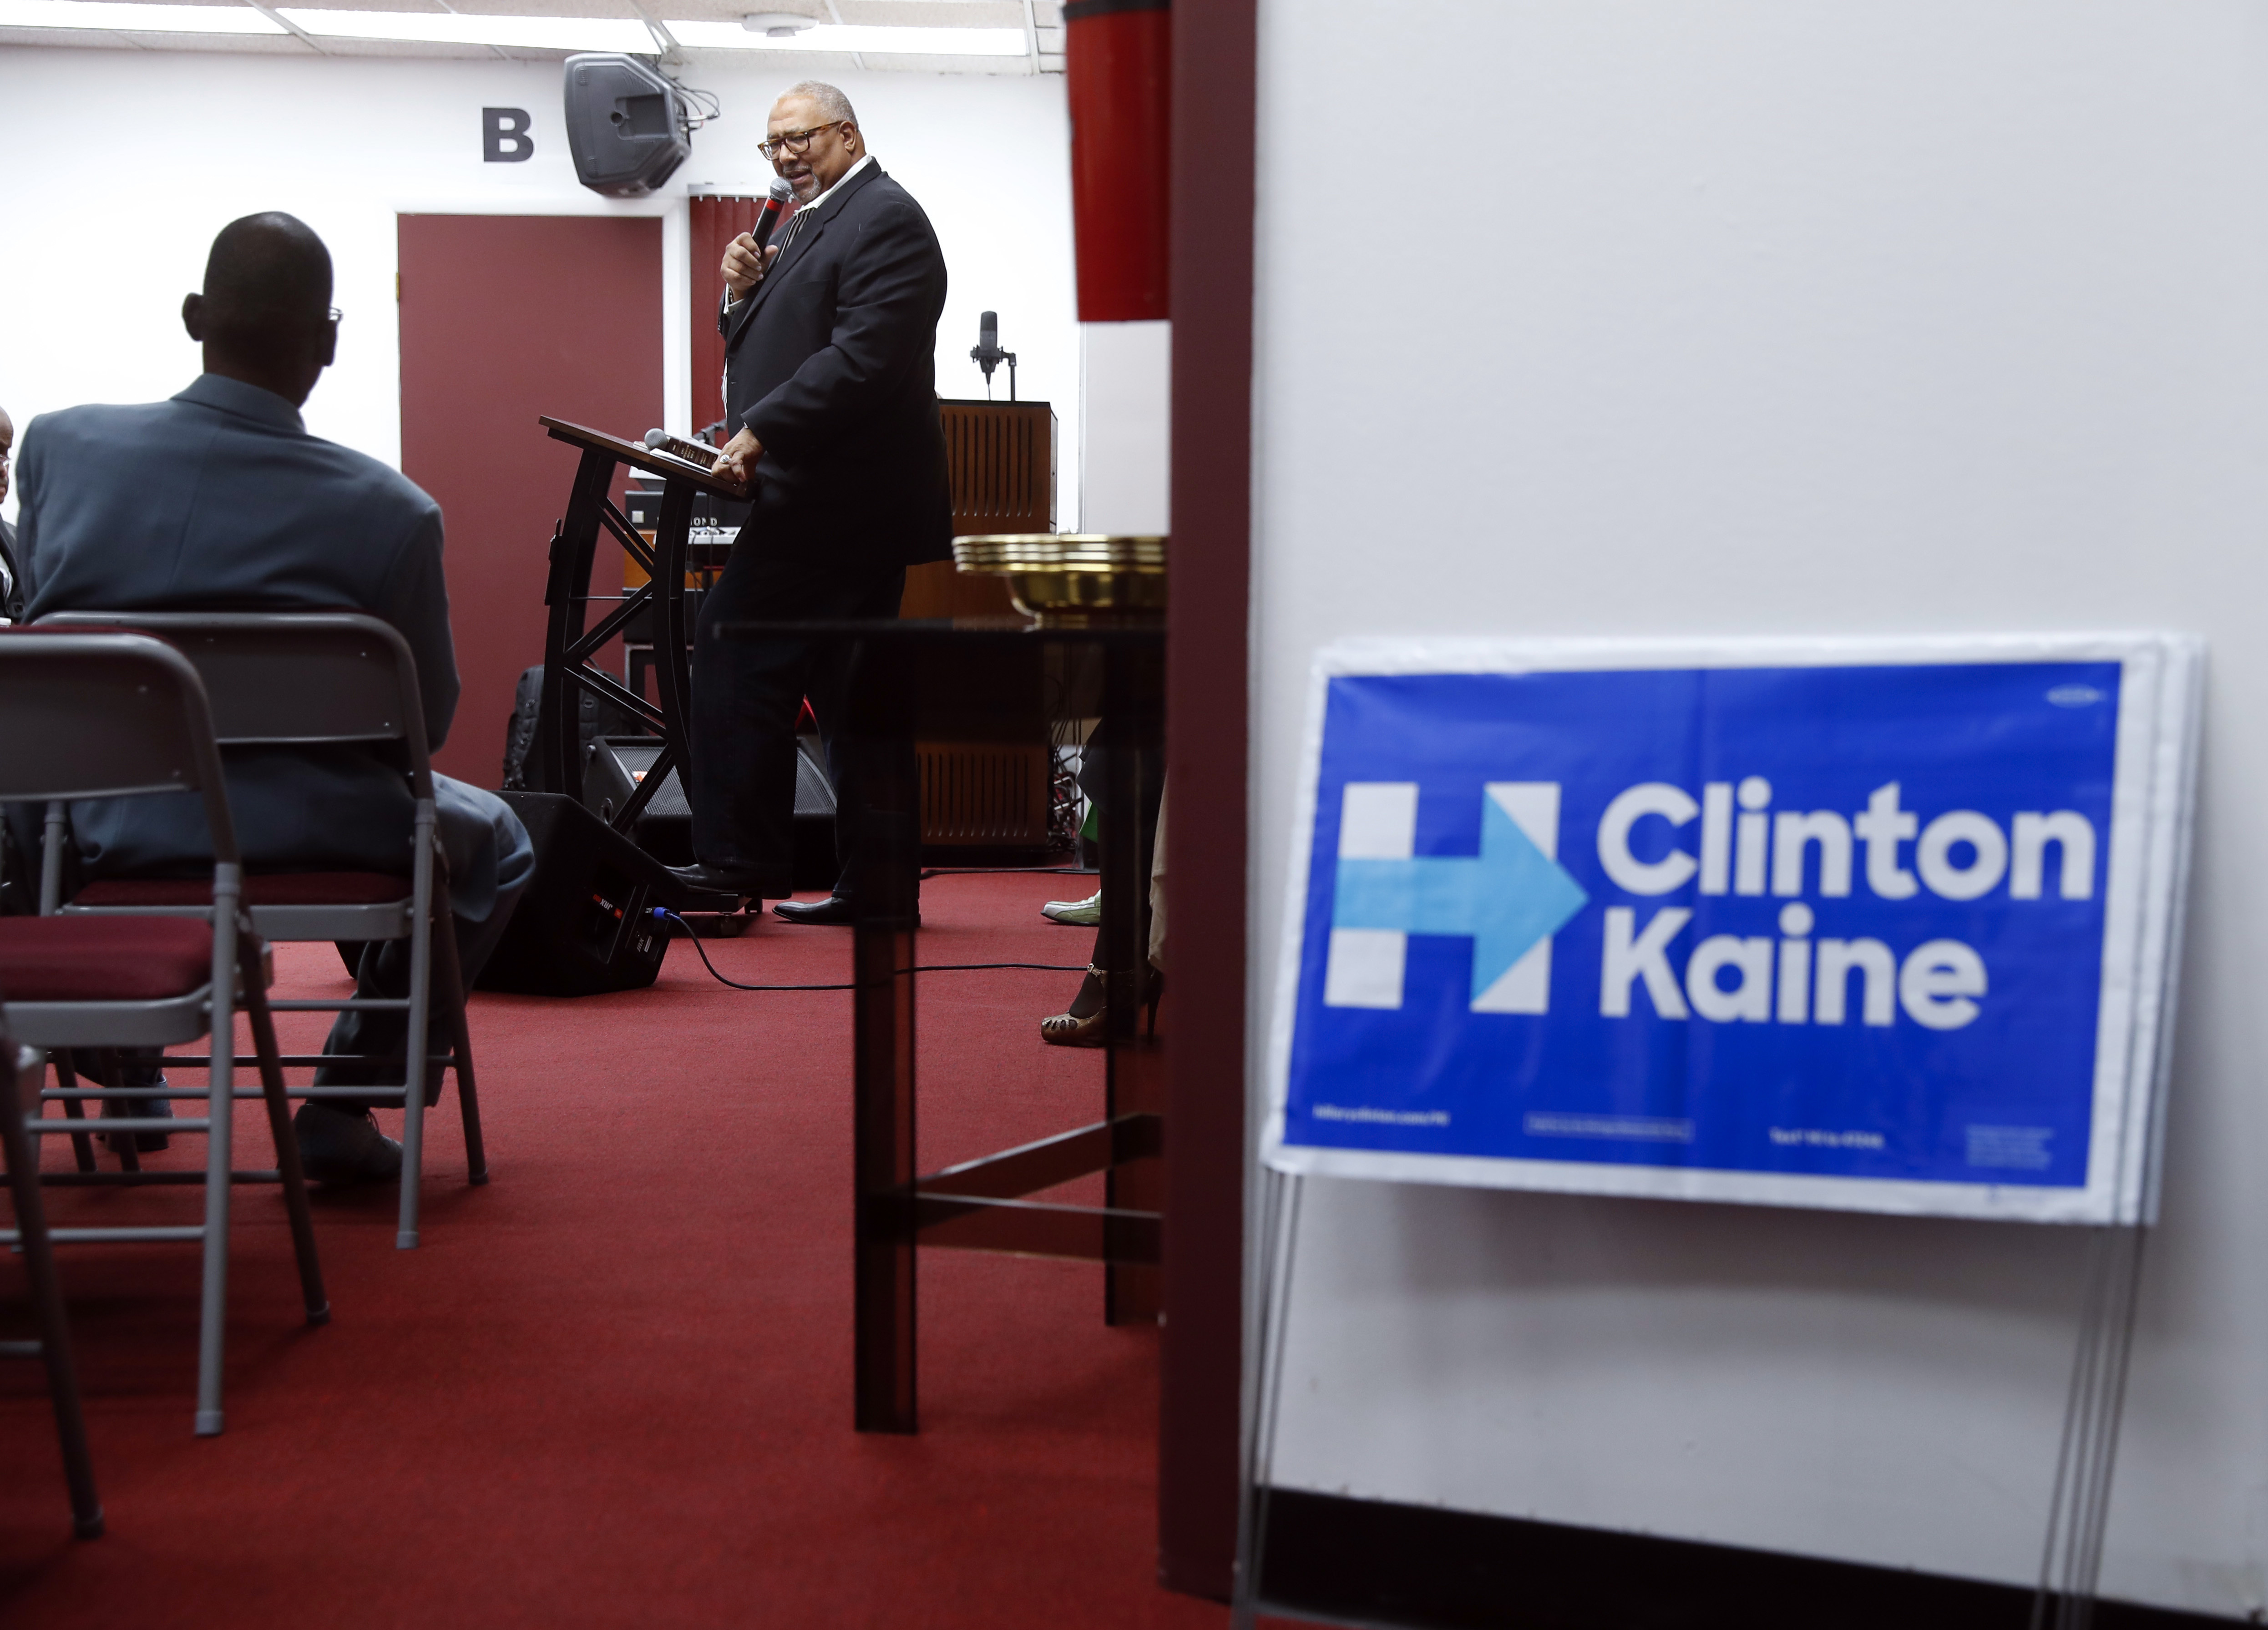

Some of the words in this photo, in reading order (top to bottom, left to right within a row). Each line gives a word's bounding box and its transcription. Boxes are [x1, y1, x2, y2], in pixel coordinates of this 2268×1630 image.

[483, 108, 534, 162] B
[1598, 777, 2095, 899] Clinton
[1601, 903, 1986, 1028] Kaine
